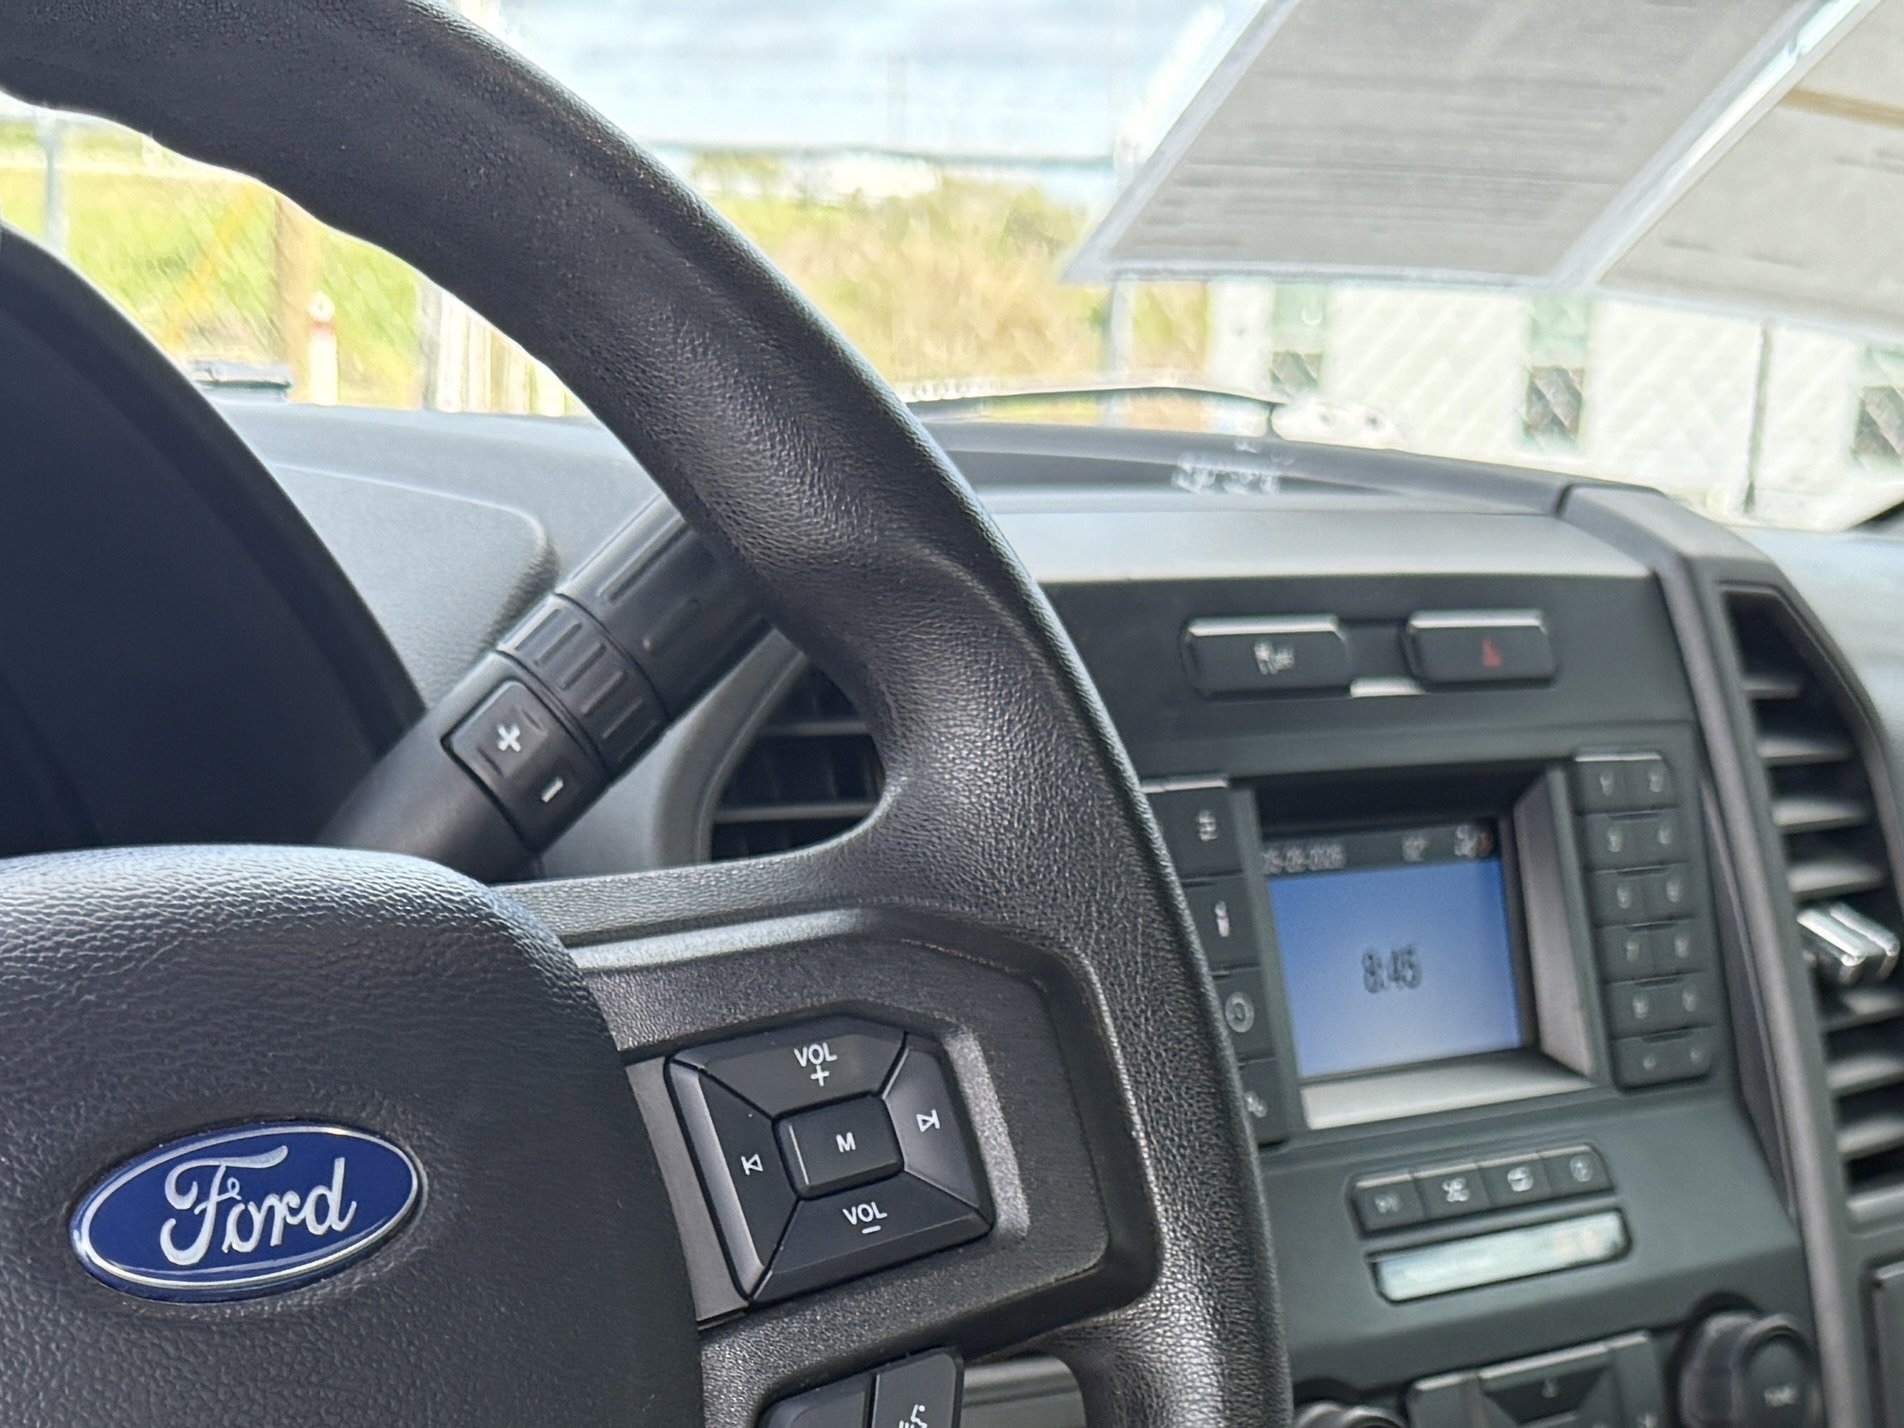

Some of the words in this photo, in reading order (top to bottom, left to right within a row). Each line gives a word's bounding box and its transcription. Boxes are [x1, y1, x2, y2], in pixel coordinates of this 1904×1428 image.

[794, 1042, 837, 1067] VOL
[836, 1132, 856, 1152] M
[160, 1144, 357, 1265] Ford
[842, 1201, 888, 1226] VOL
